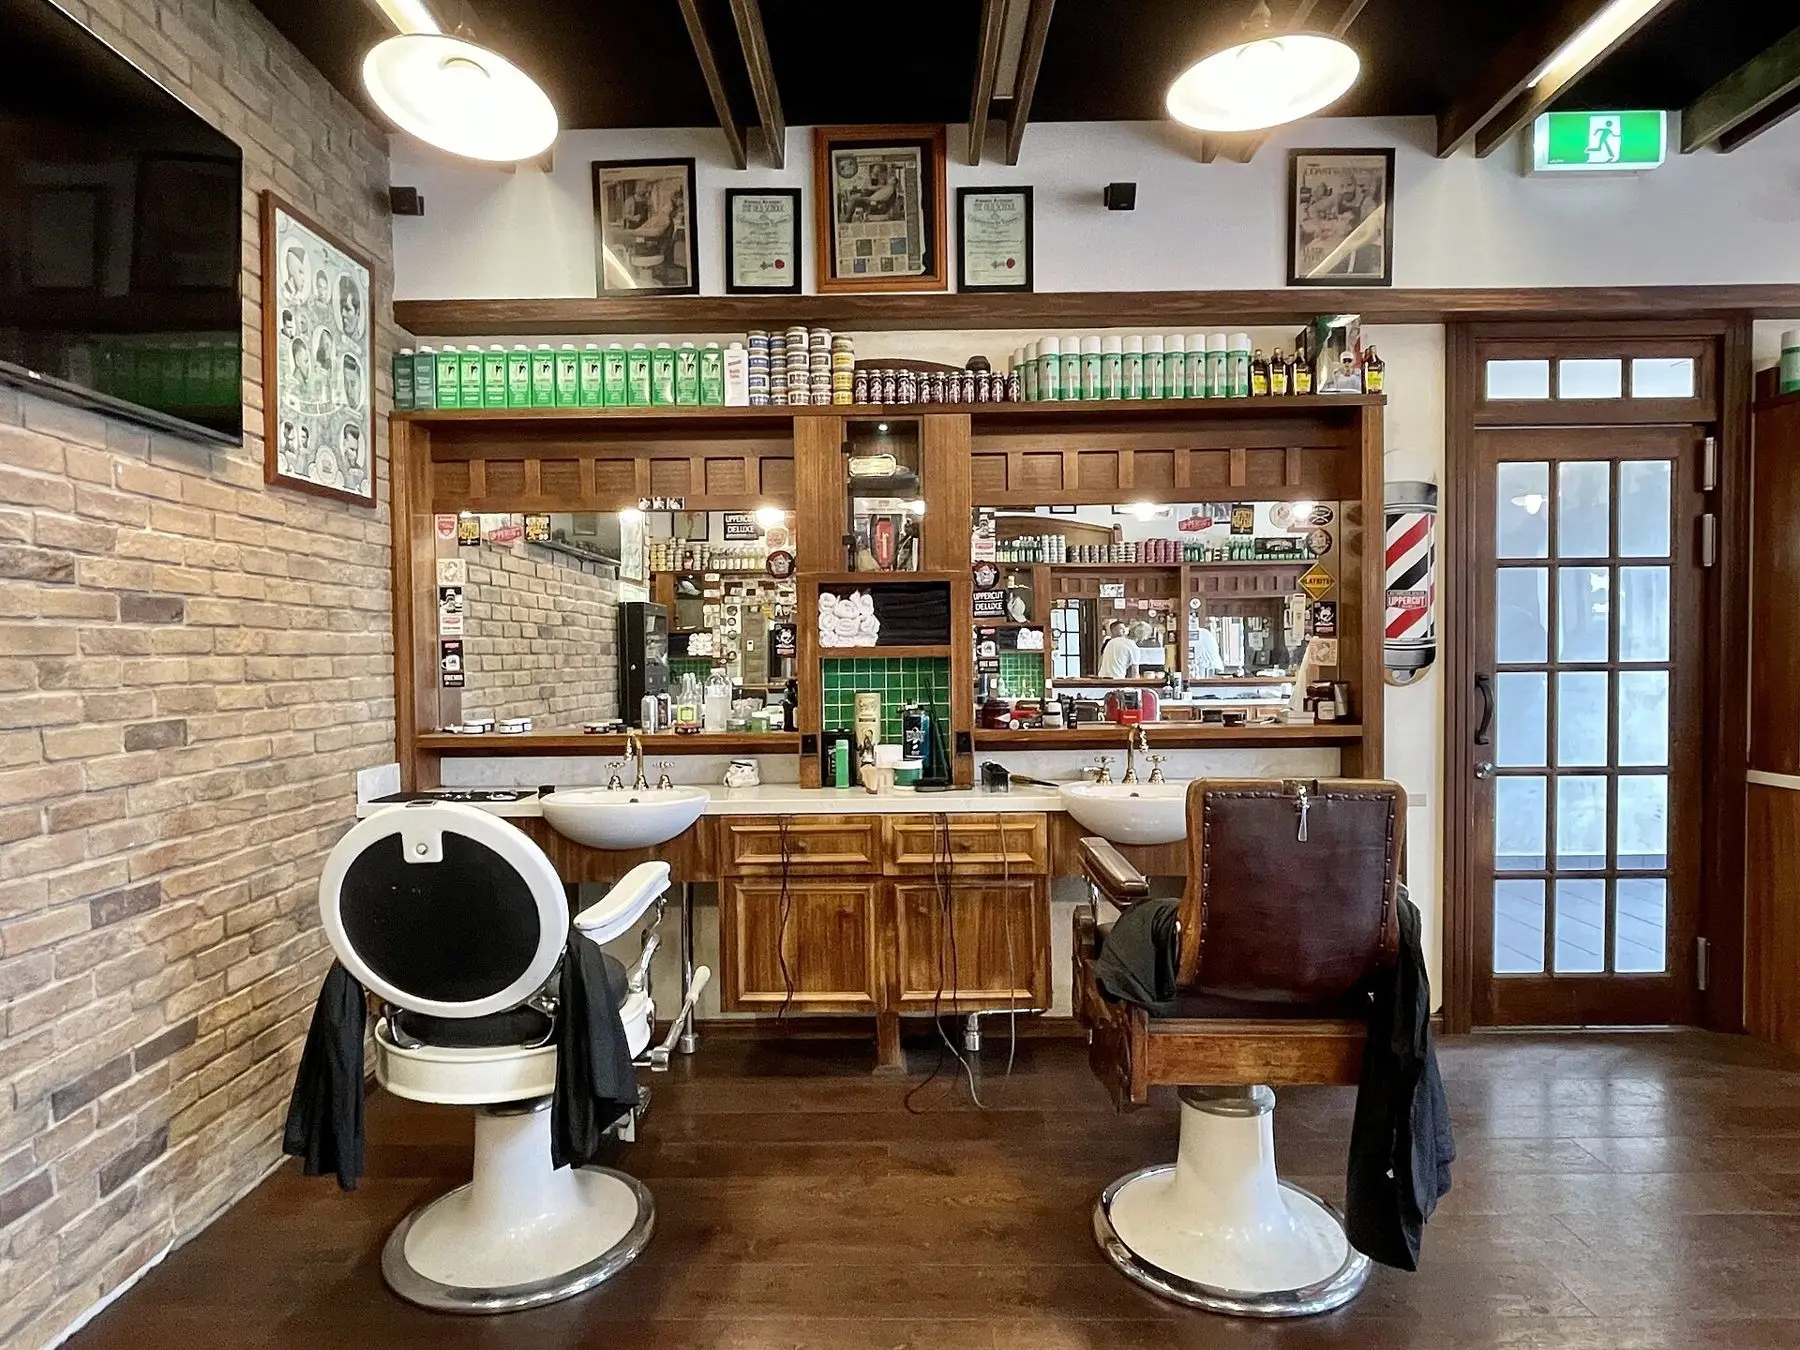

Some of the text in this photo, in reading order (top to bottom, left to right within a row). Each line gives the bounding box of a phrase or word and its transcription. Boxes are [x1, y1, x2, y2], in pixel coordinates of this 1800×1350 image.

[973, 591, 1004, 600] UPPERCUT
[1388, 595, 1425, 606] UPPERCUT
[975, 602, 1003, 610] DELUXE
